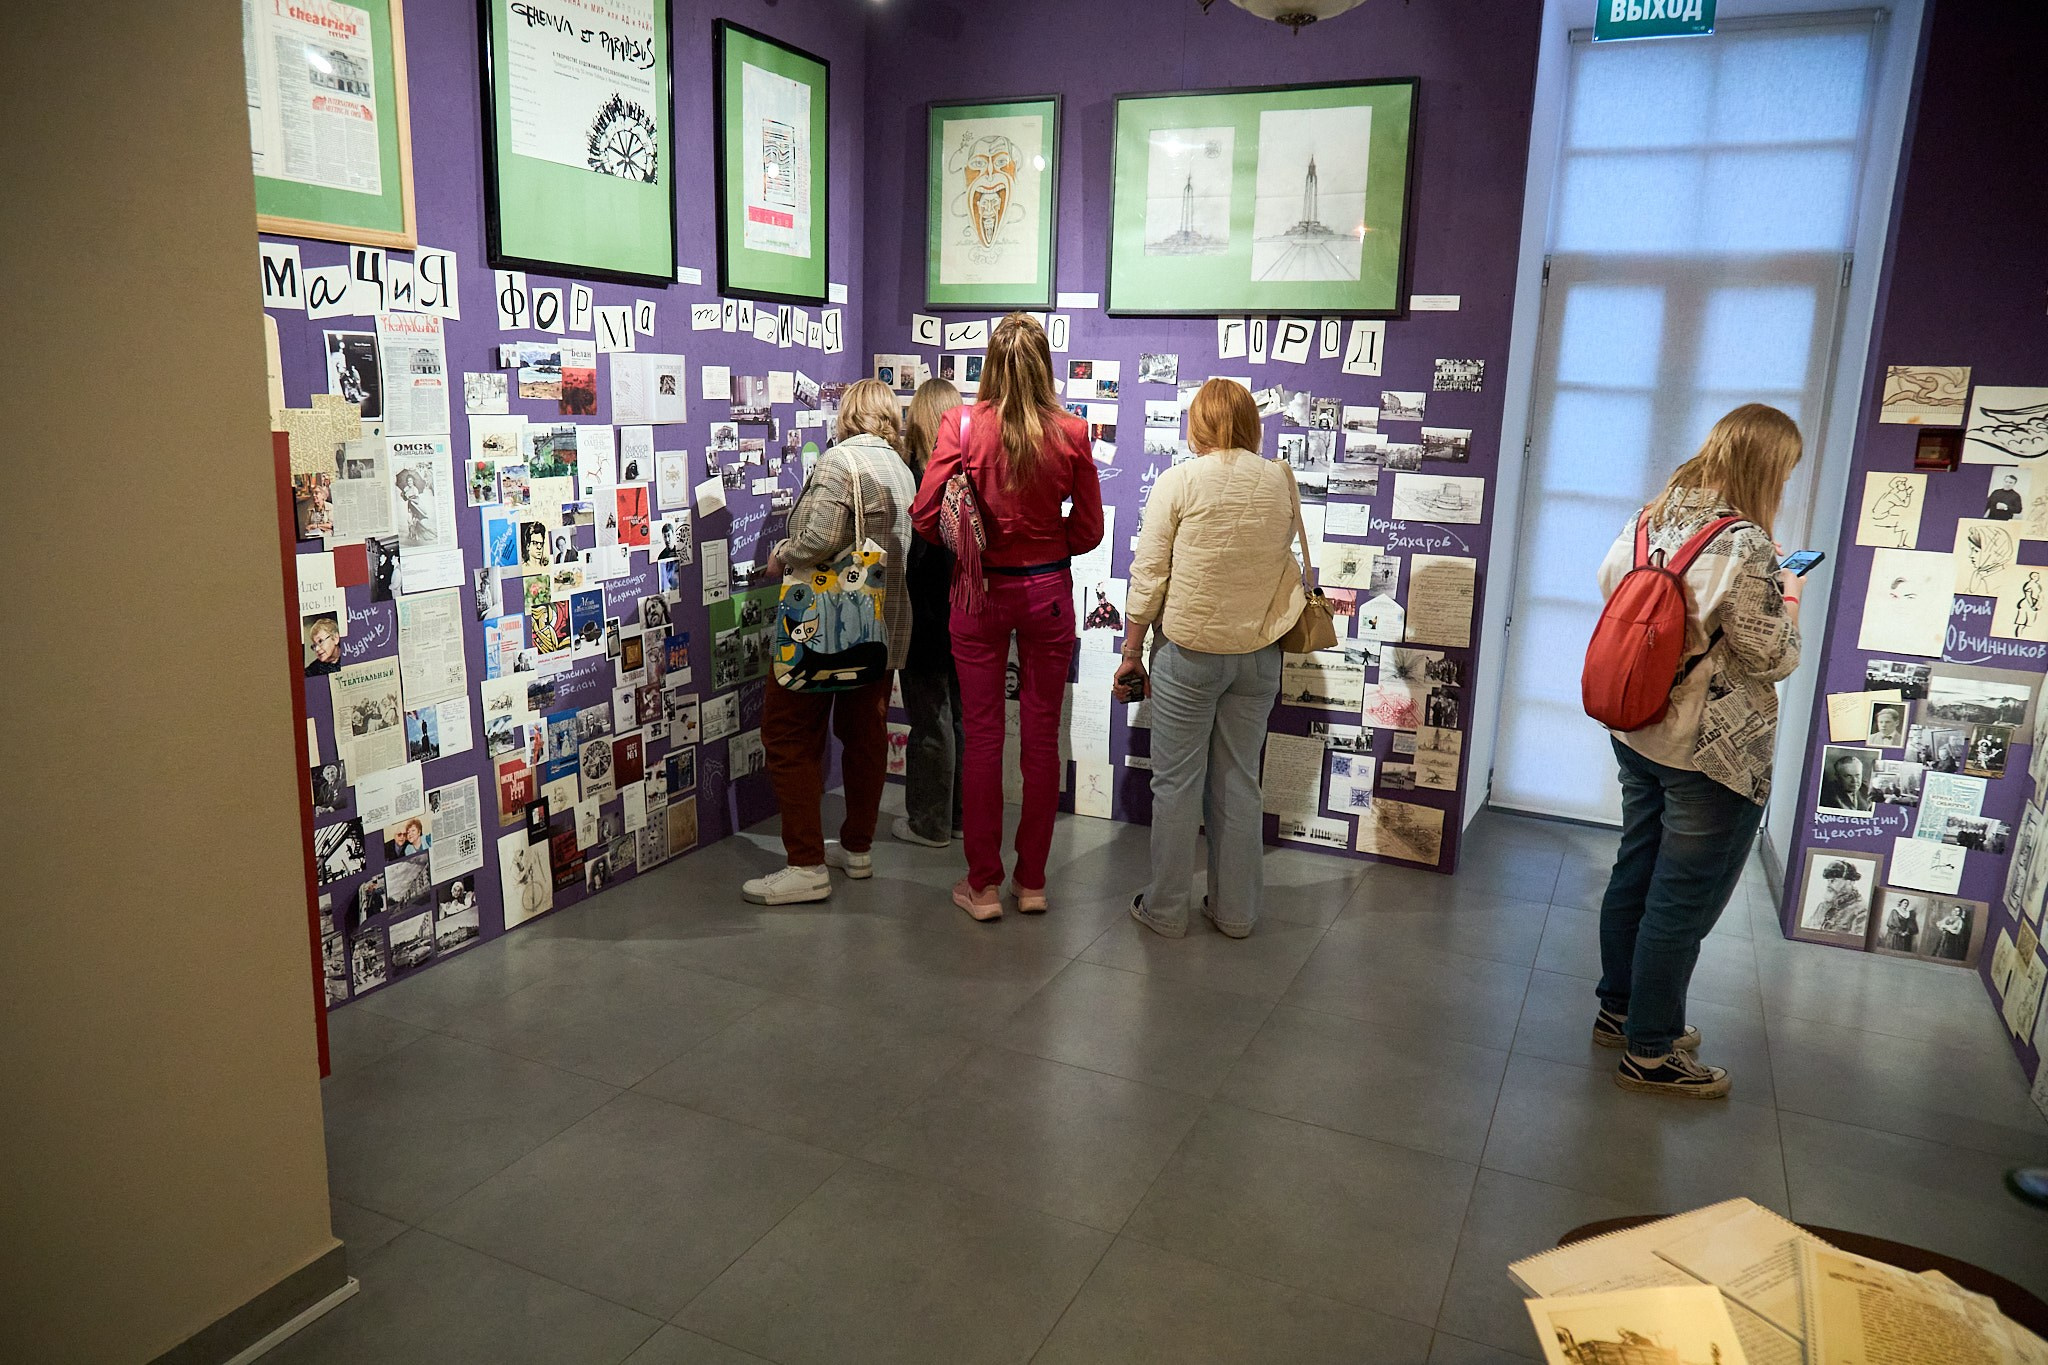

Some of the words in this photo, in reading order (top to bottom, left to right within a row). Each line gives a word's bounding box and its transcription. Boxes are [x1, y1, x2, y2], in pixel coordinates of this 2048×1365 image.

[289, 6, 357, 36] theatrical
[1610, 0, 1702, 22] ВЫХОД
[328, 30, 350, 40] review
[580, 30, 594, 43] ET
[599, 31, 656, 70] PARADISUS
[1223, 320, 1377, 371] ГОРОД
[393, 443, 433, 452] ОМСК
[1386, 532, 1452, 552] Захаров
[347, 606, 379, 626] Марк
[342, 623, 385, 657] Мудрик
[1945, 624, 2047, 658] Овчинников
[558, 680, 596, 697] Белан
[1815, 812, 1899, 826] Константин
[1812, 826, 1884, 843] Щекотов
